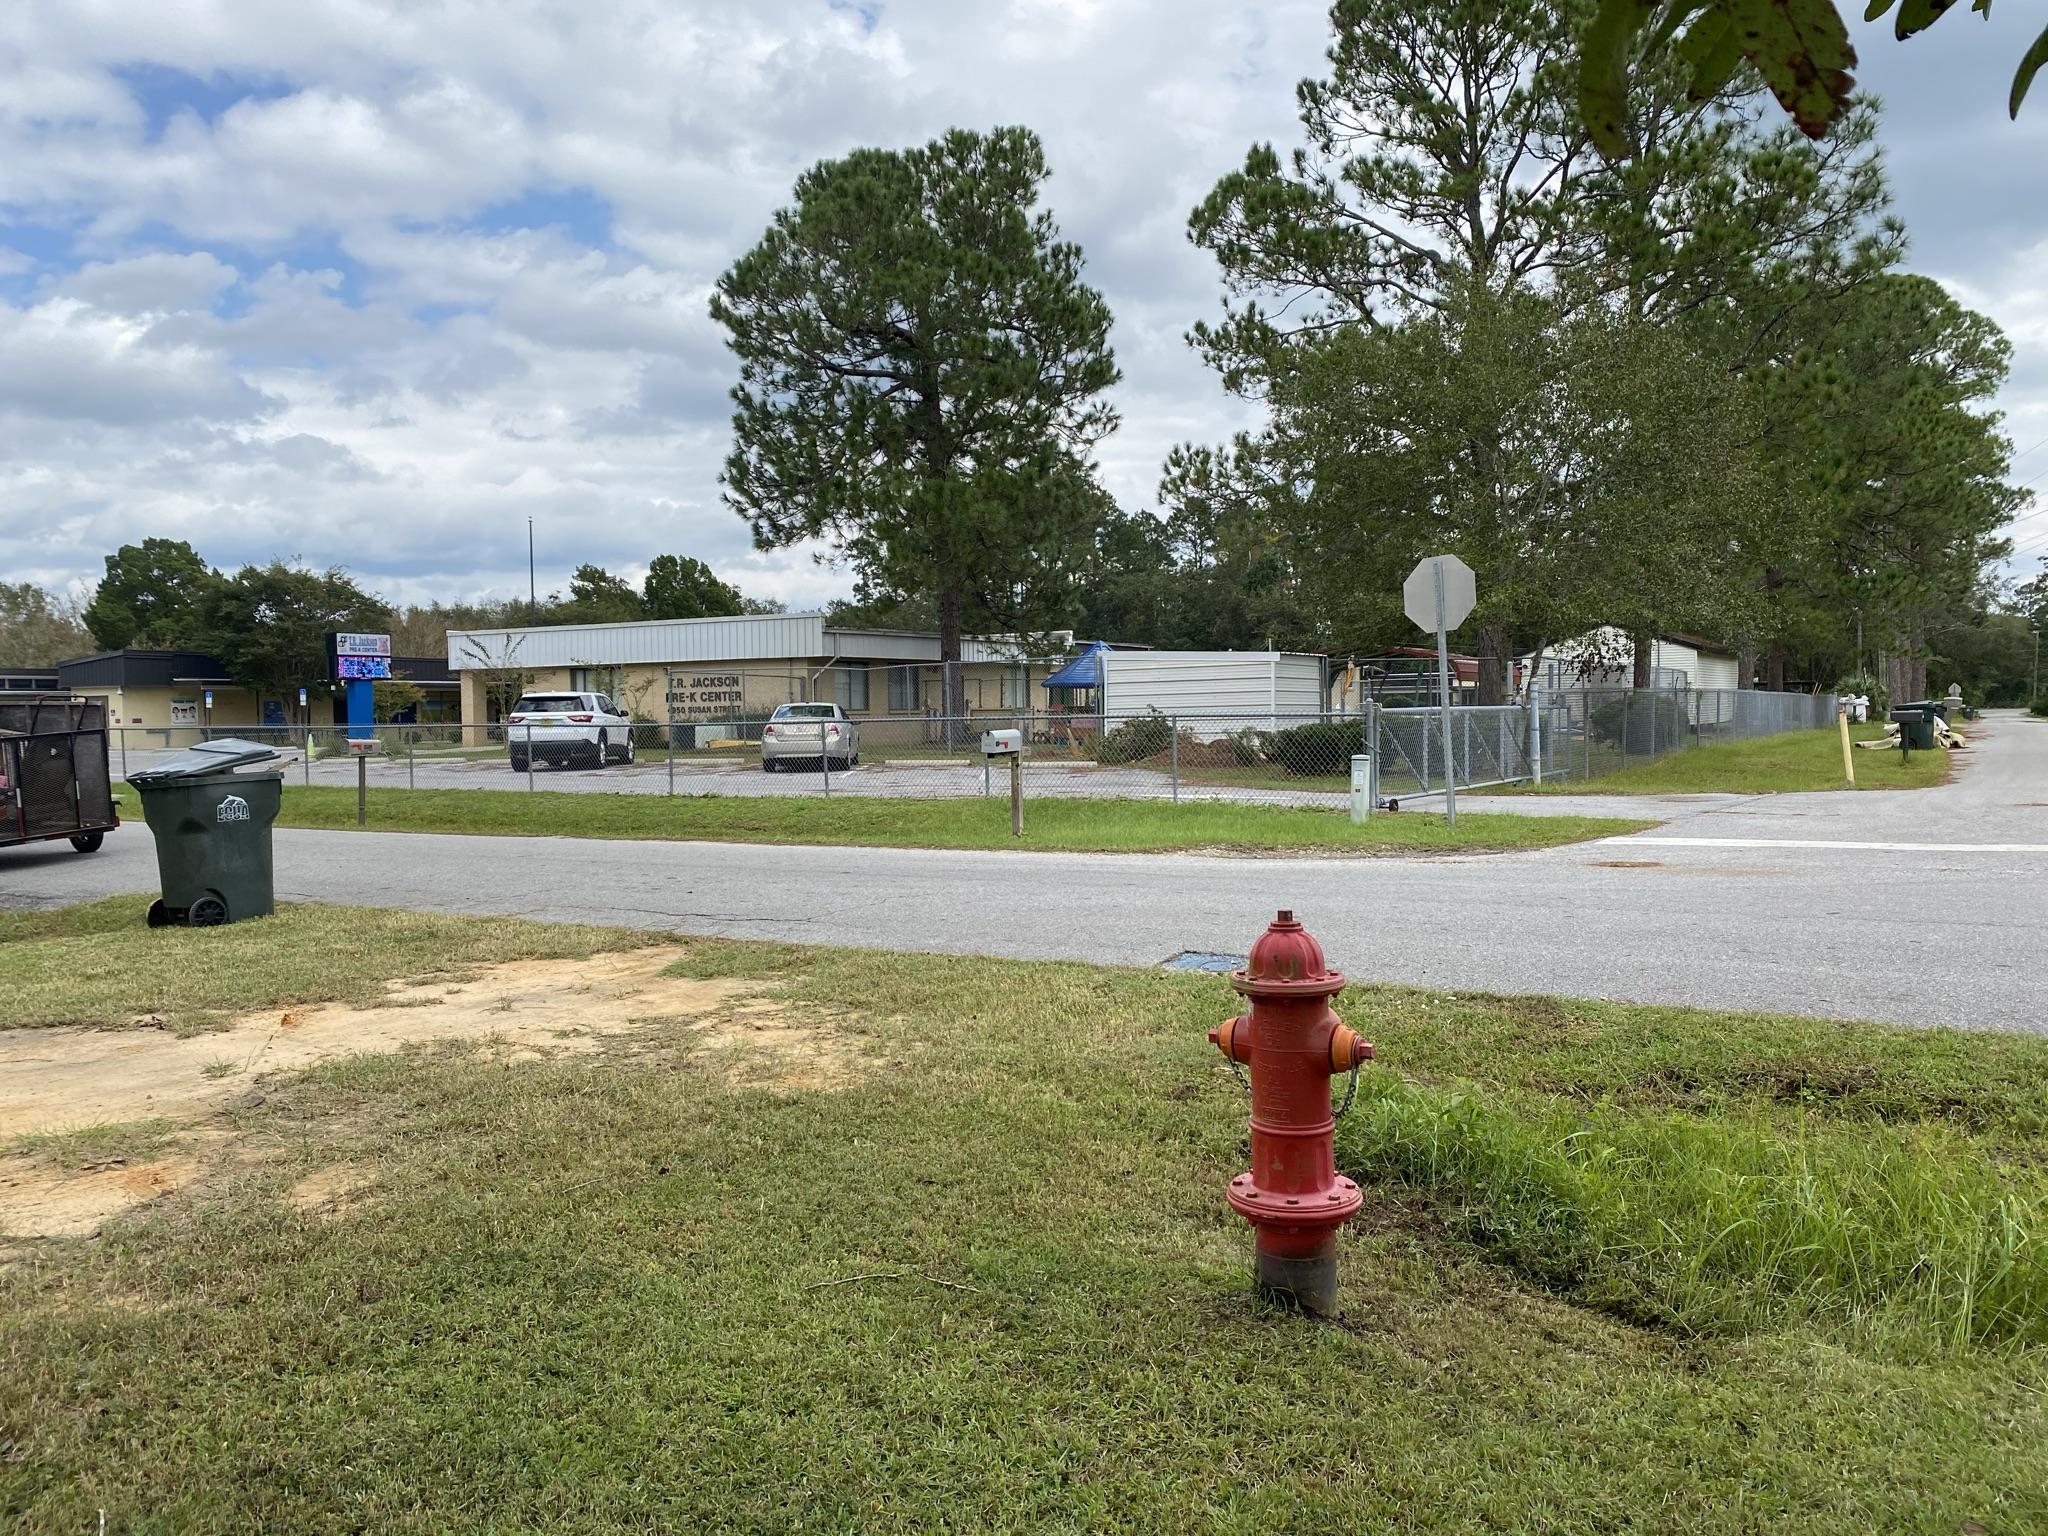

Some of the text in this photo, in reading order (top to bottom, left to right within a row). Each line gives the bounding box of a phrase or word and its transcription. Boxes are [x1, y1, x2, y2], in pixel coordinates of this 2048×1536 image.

[690, 676, 739, 689] JACKSON
[700, 691, 742, 702] CENTER
[687, 705, 712, 714] SUSAN
[714, 705, 741, 713] STREET
